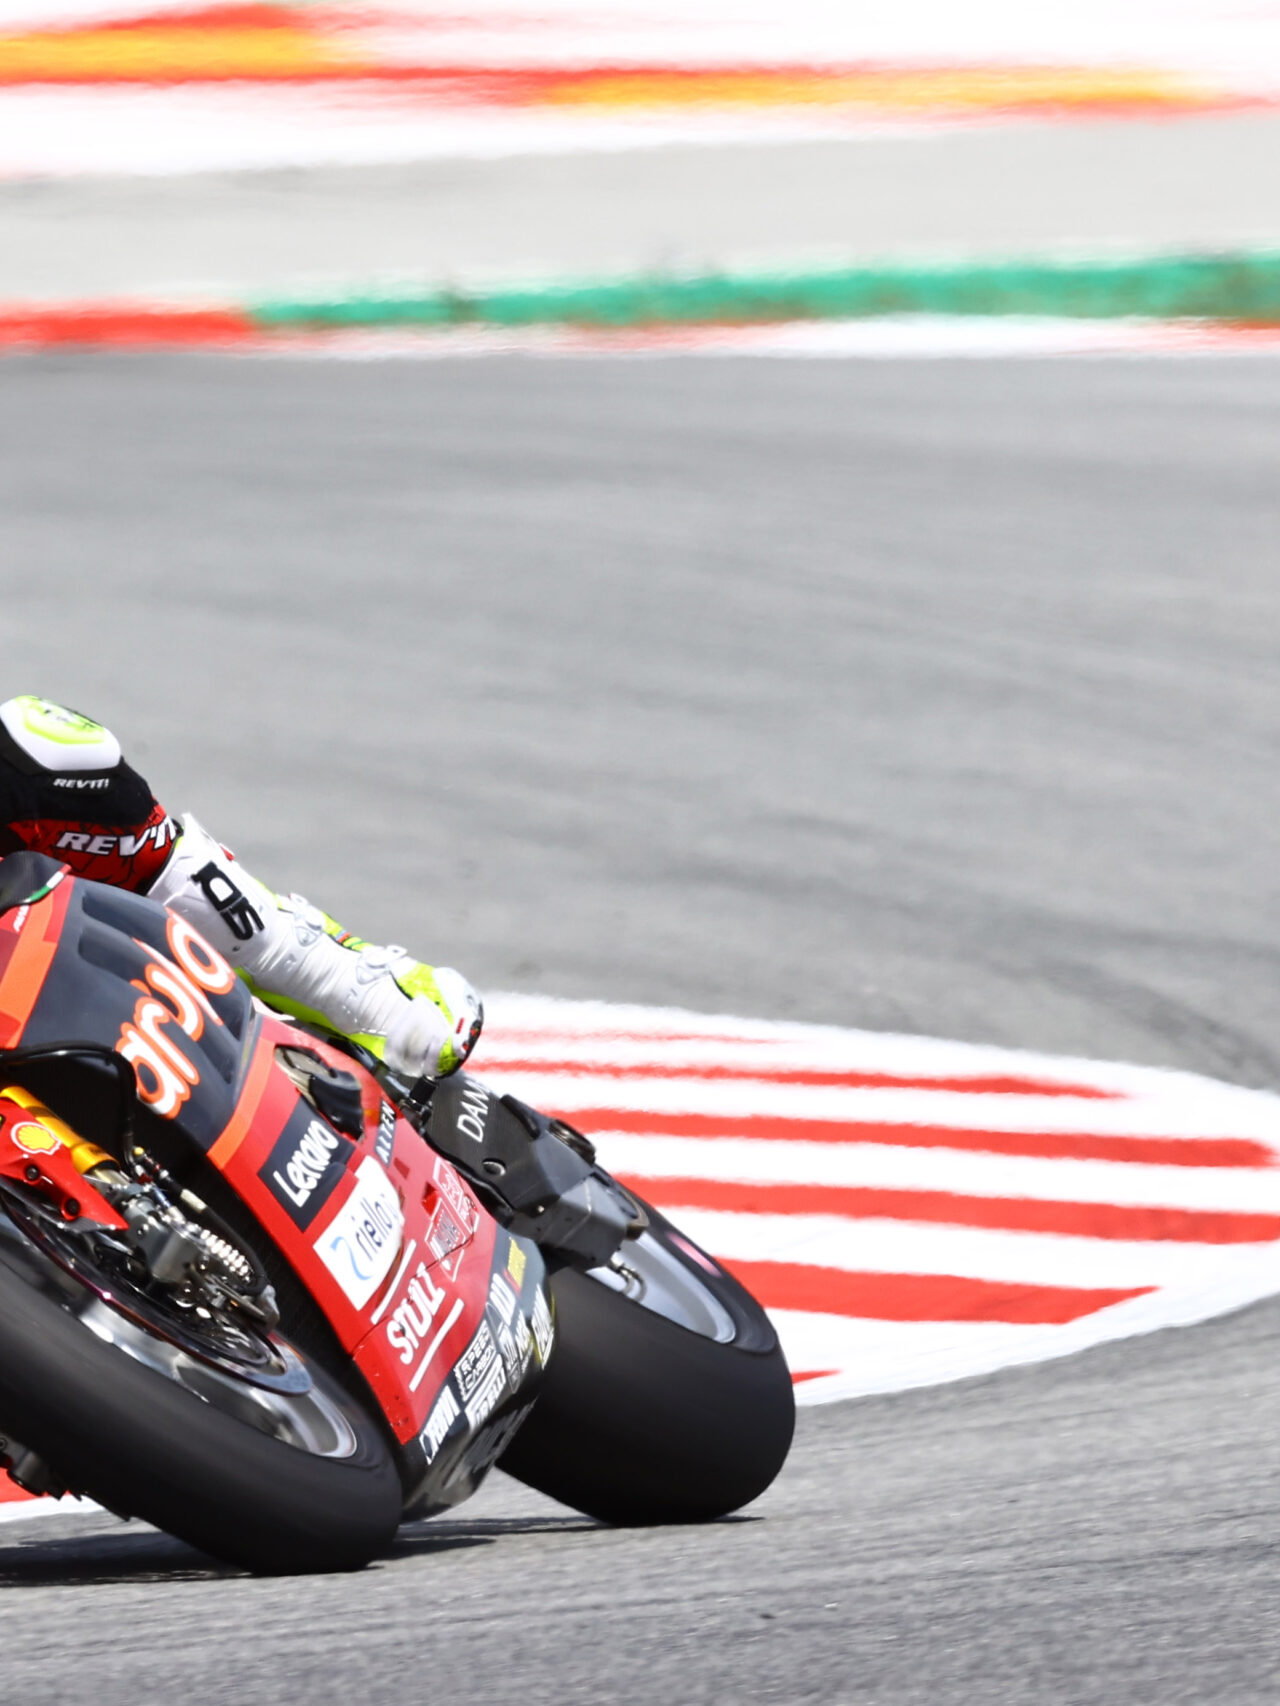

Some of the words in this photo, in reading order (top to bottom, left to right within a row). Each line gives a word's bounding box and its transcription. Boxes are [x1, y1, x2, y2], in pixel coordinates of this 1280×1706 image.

[273, 1119, 339, 1209] Lenovo
[374, 1100, 396, 1163] ALTEN
[386, 1262, 447, 1366] STULZ
